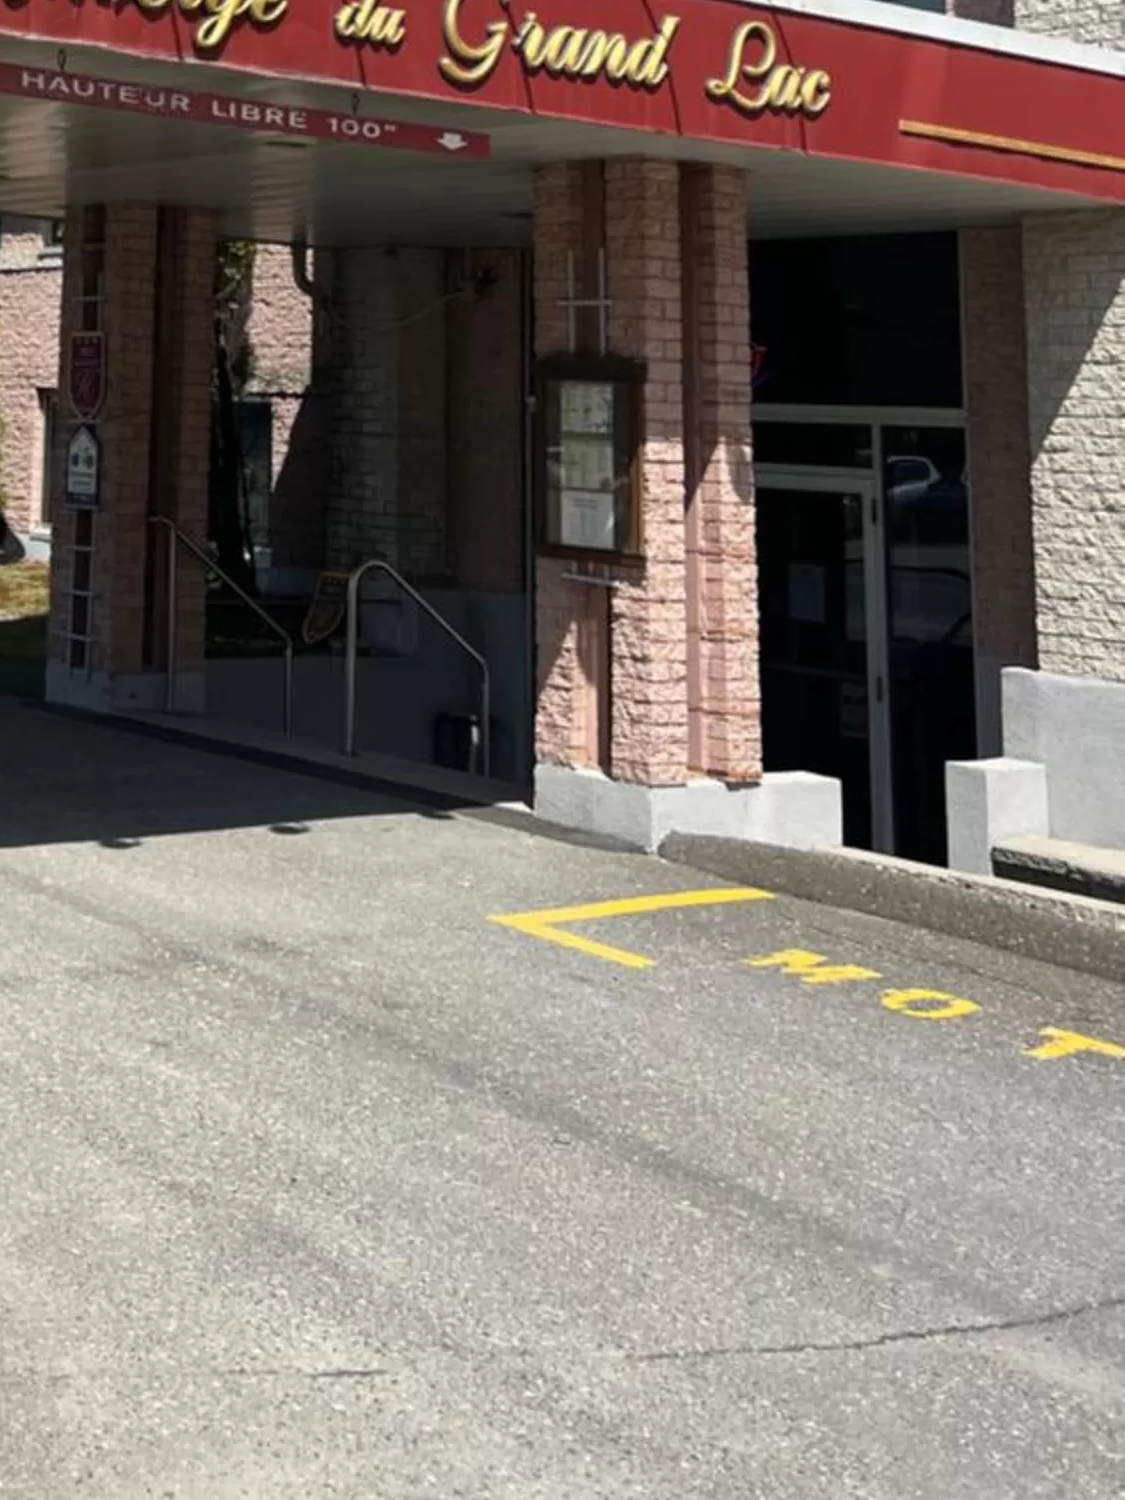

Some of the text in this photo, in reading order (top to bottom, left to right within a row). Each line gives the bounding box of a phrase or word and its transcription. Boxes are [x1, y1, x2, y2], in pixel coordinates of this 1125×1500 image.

[22, 70, 190, 112] HAUTEUR
[212, 100, 307, 129] LIBRE
[704, 20, 832, 112] Lac
